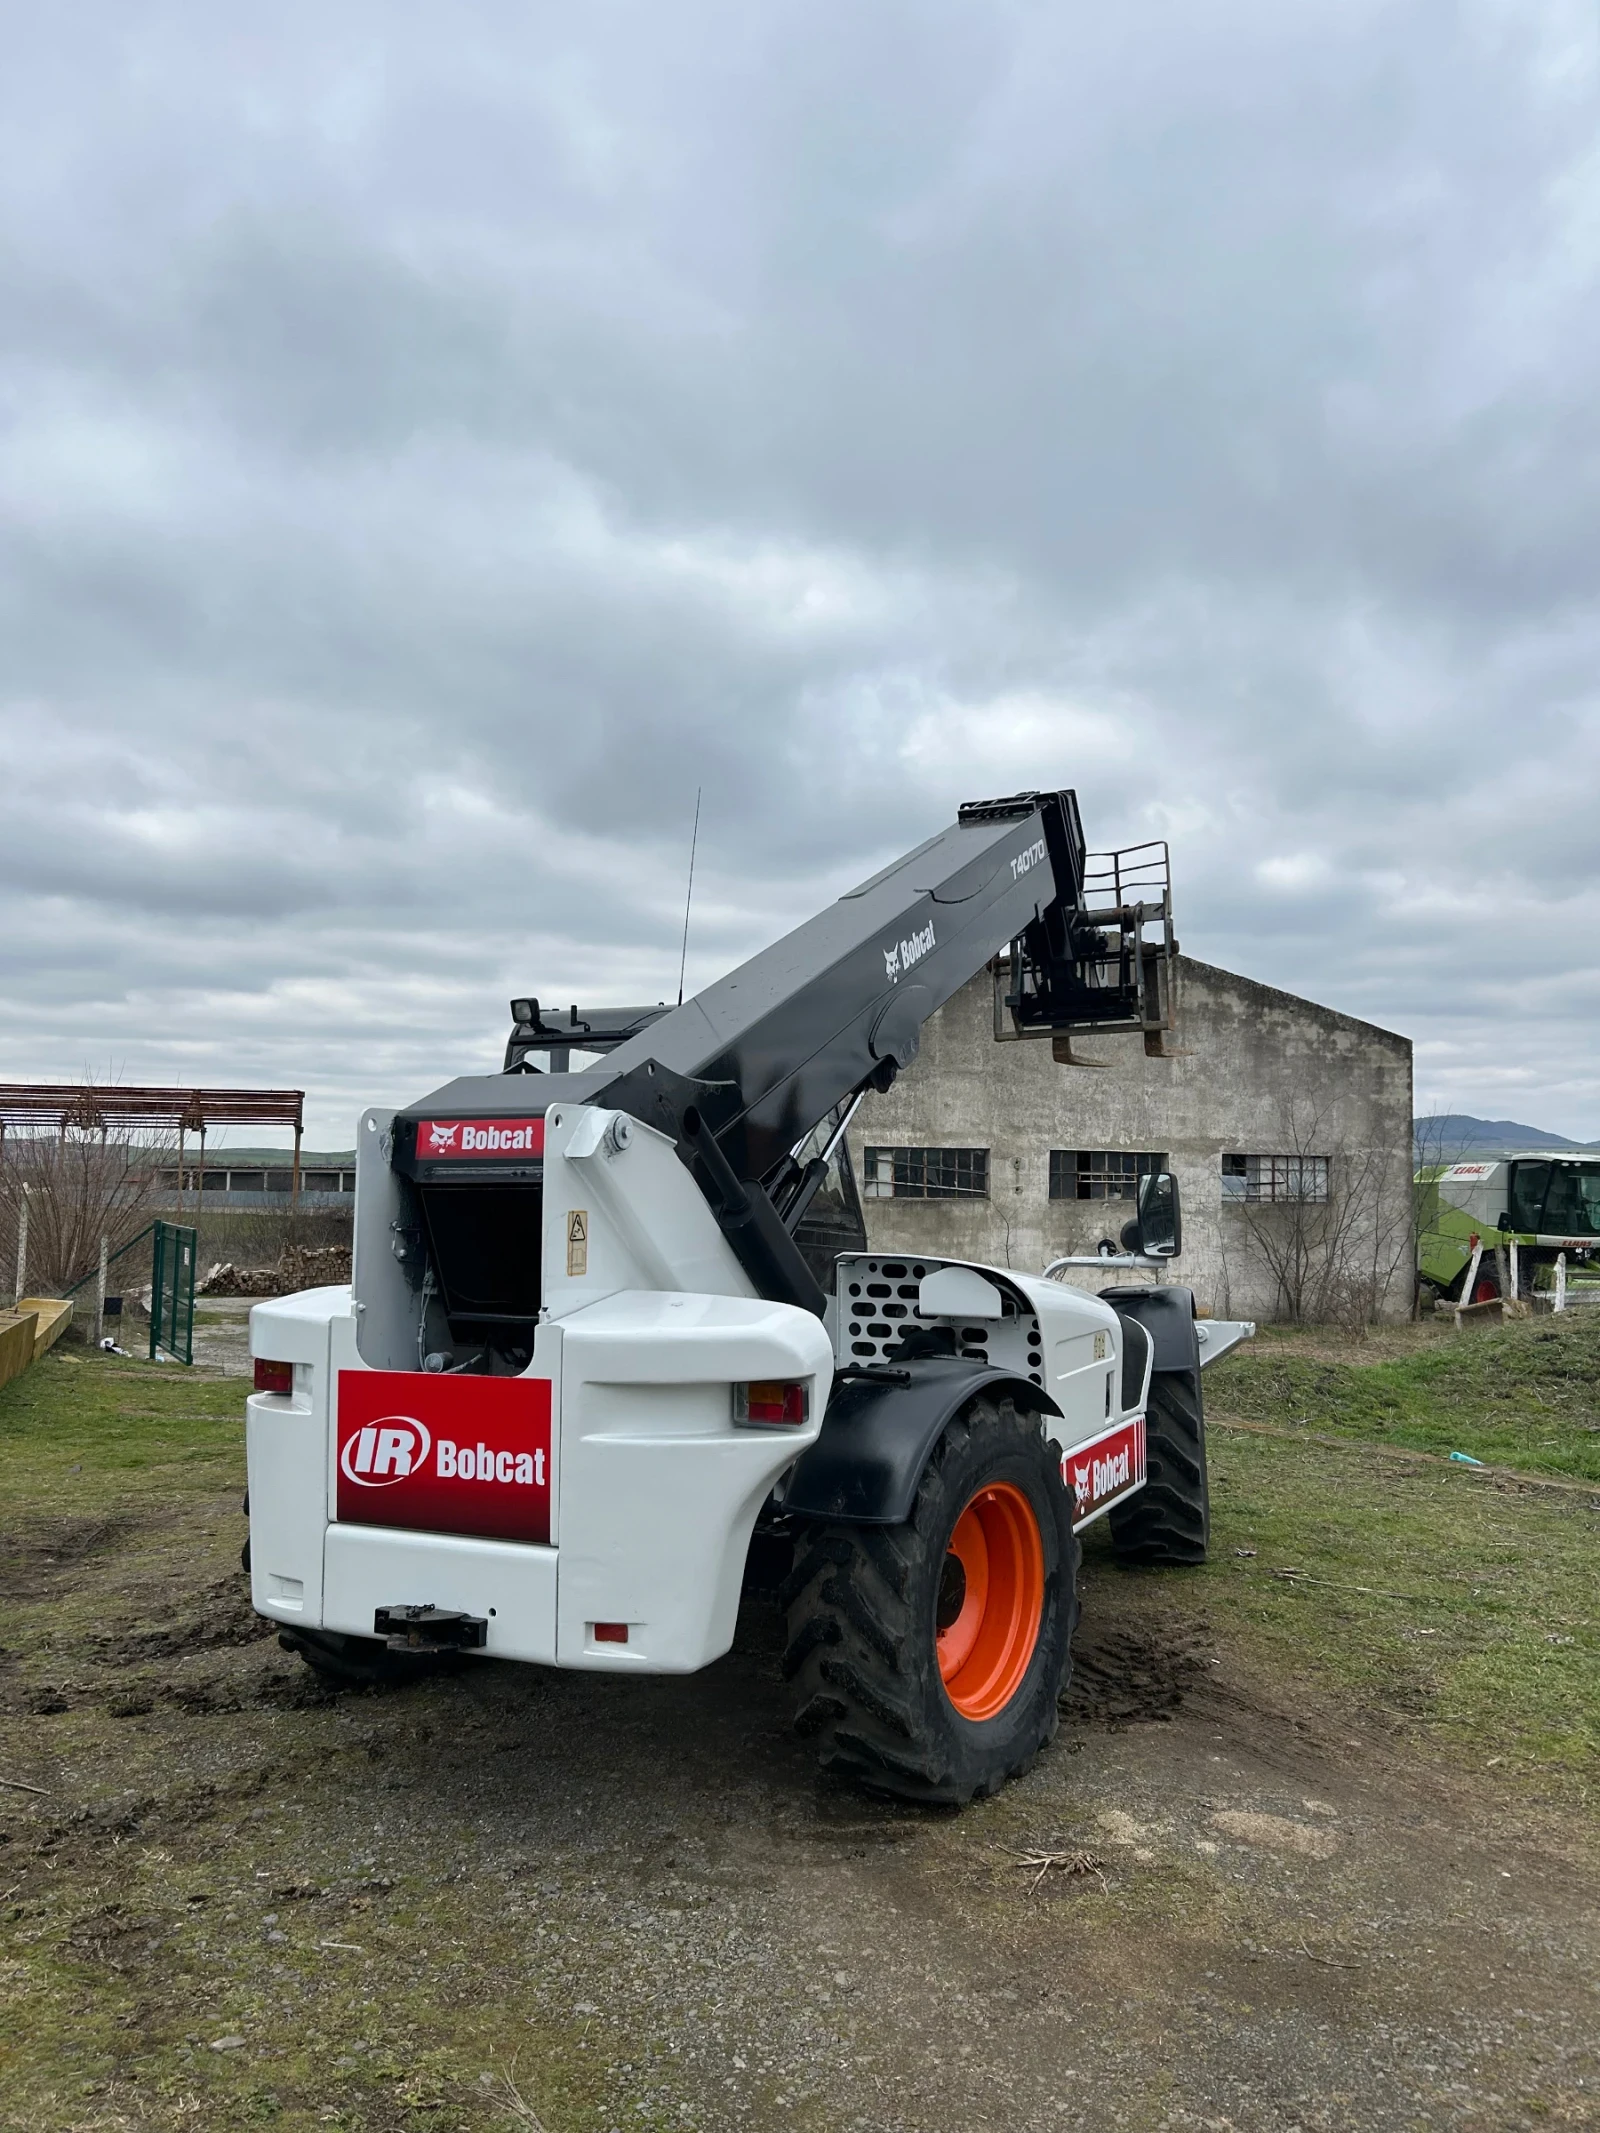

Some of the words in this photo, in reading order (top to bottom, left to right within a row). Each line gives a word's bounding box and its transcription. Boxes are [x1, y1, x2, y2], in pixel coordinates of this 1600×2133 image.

[1010, 838, 1045, 880] T40170
[900, 920, 936, 970] Bobcat
[461, 1125, 533, 1151] Bobcat
[354, 1427, 415, 1476] IR
[437, 1440, 545, 1486] Bobcat
[1092, 1444, 1130, 1501] Bobcat
